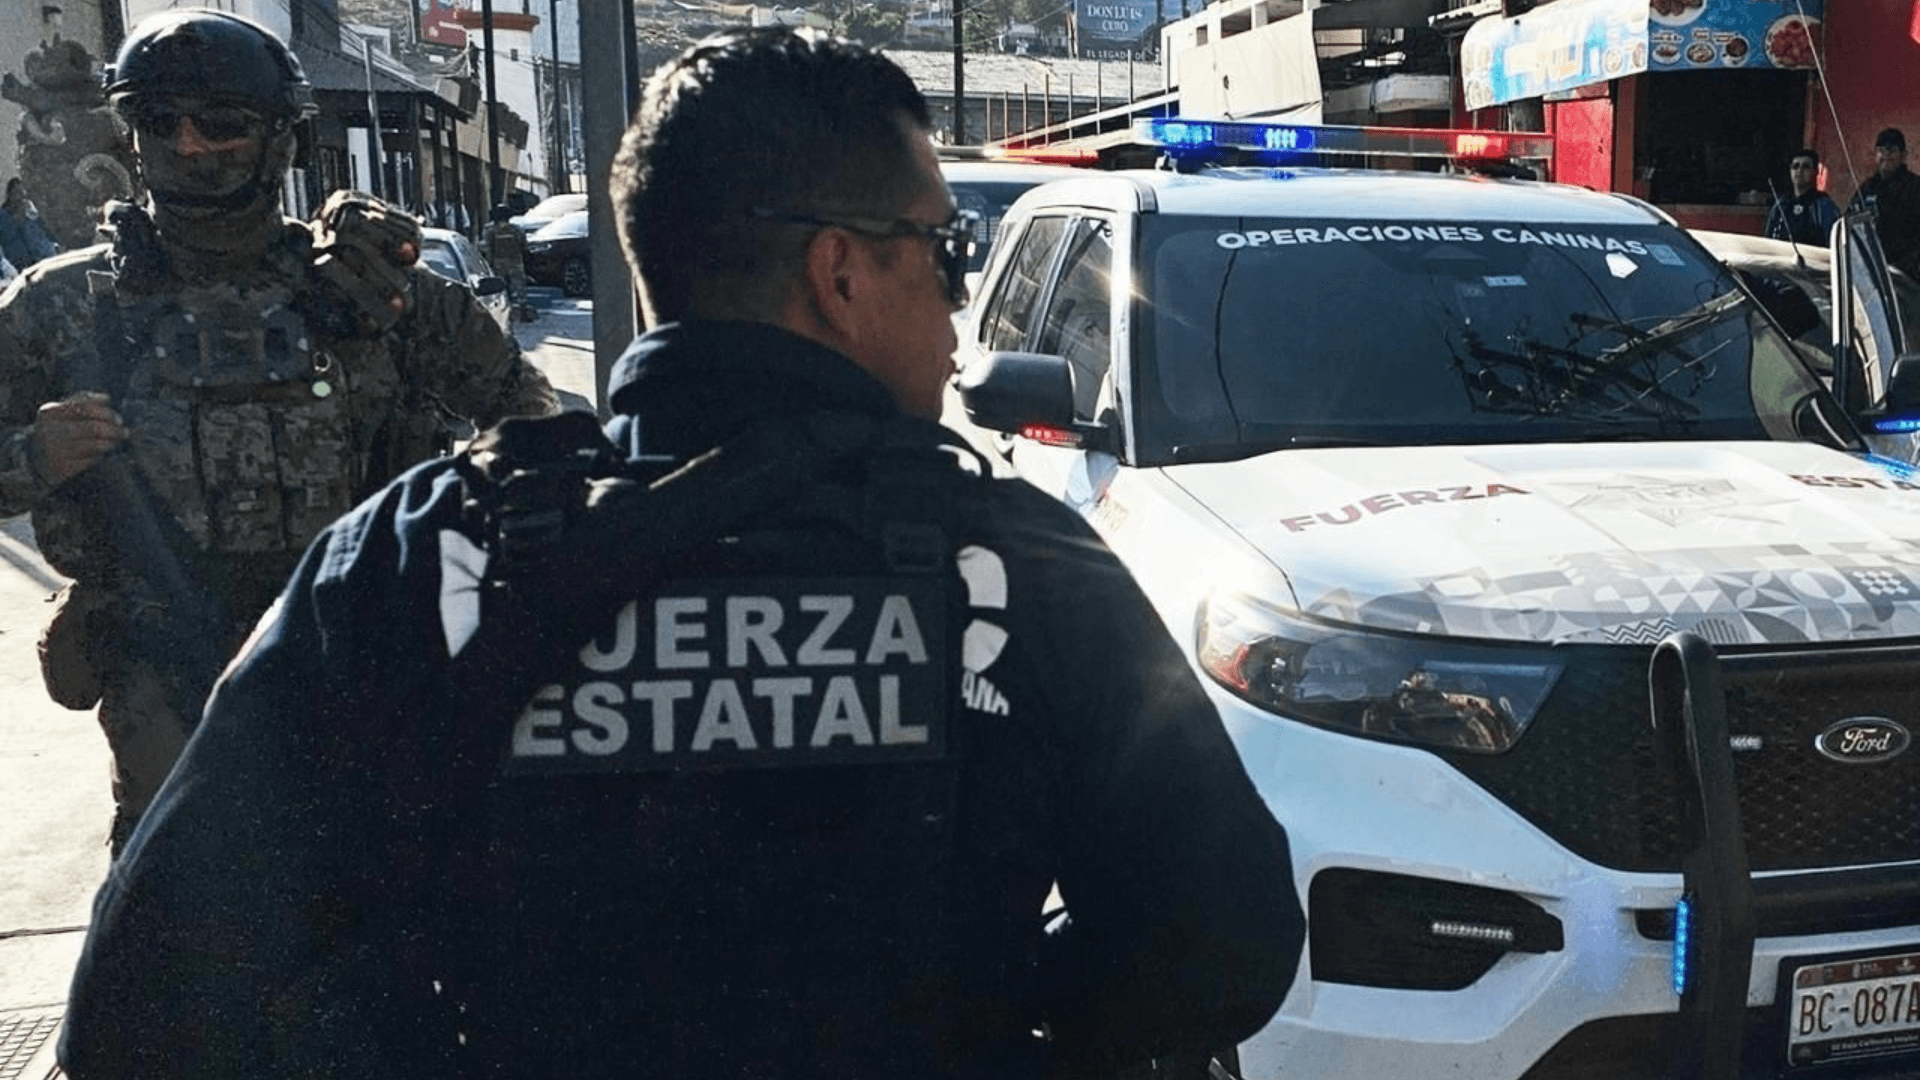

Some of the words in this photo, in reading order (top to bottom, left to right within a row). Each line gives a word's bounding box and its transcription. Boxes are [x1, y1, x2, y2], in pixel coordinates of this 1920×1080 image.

[1217, 225, 1484, 249] OPERACIONES
[1492, 228, 1648, 256] CANINAS
[1280, 484, 1532, 532] FUERZA
[579, 595, 929, 672] UERZA
[512, 674, 929, 757] ESTATAL
[1841, 727, 1891, 753] Ford
